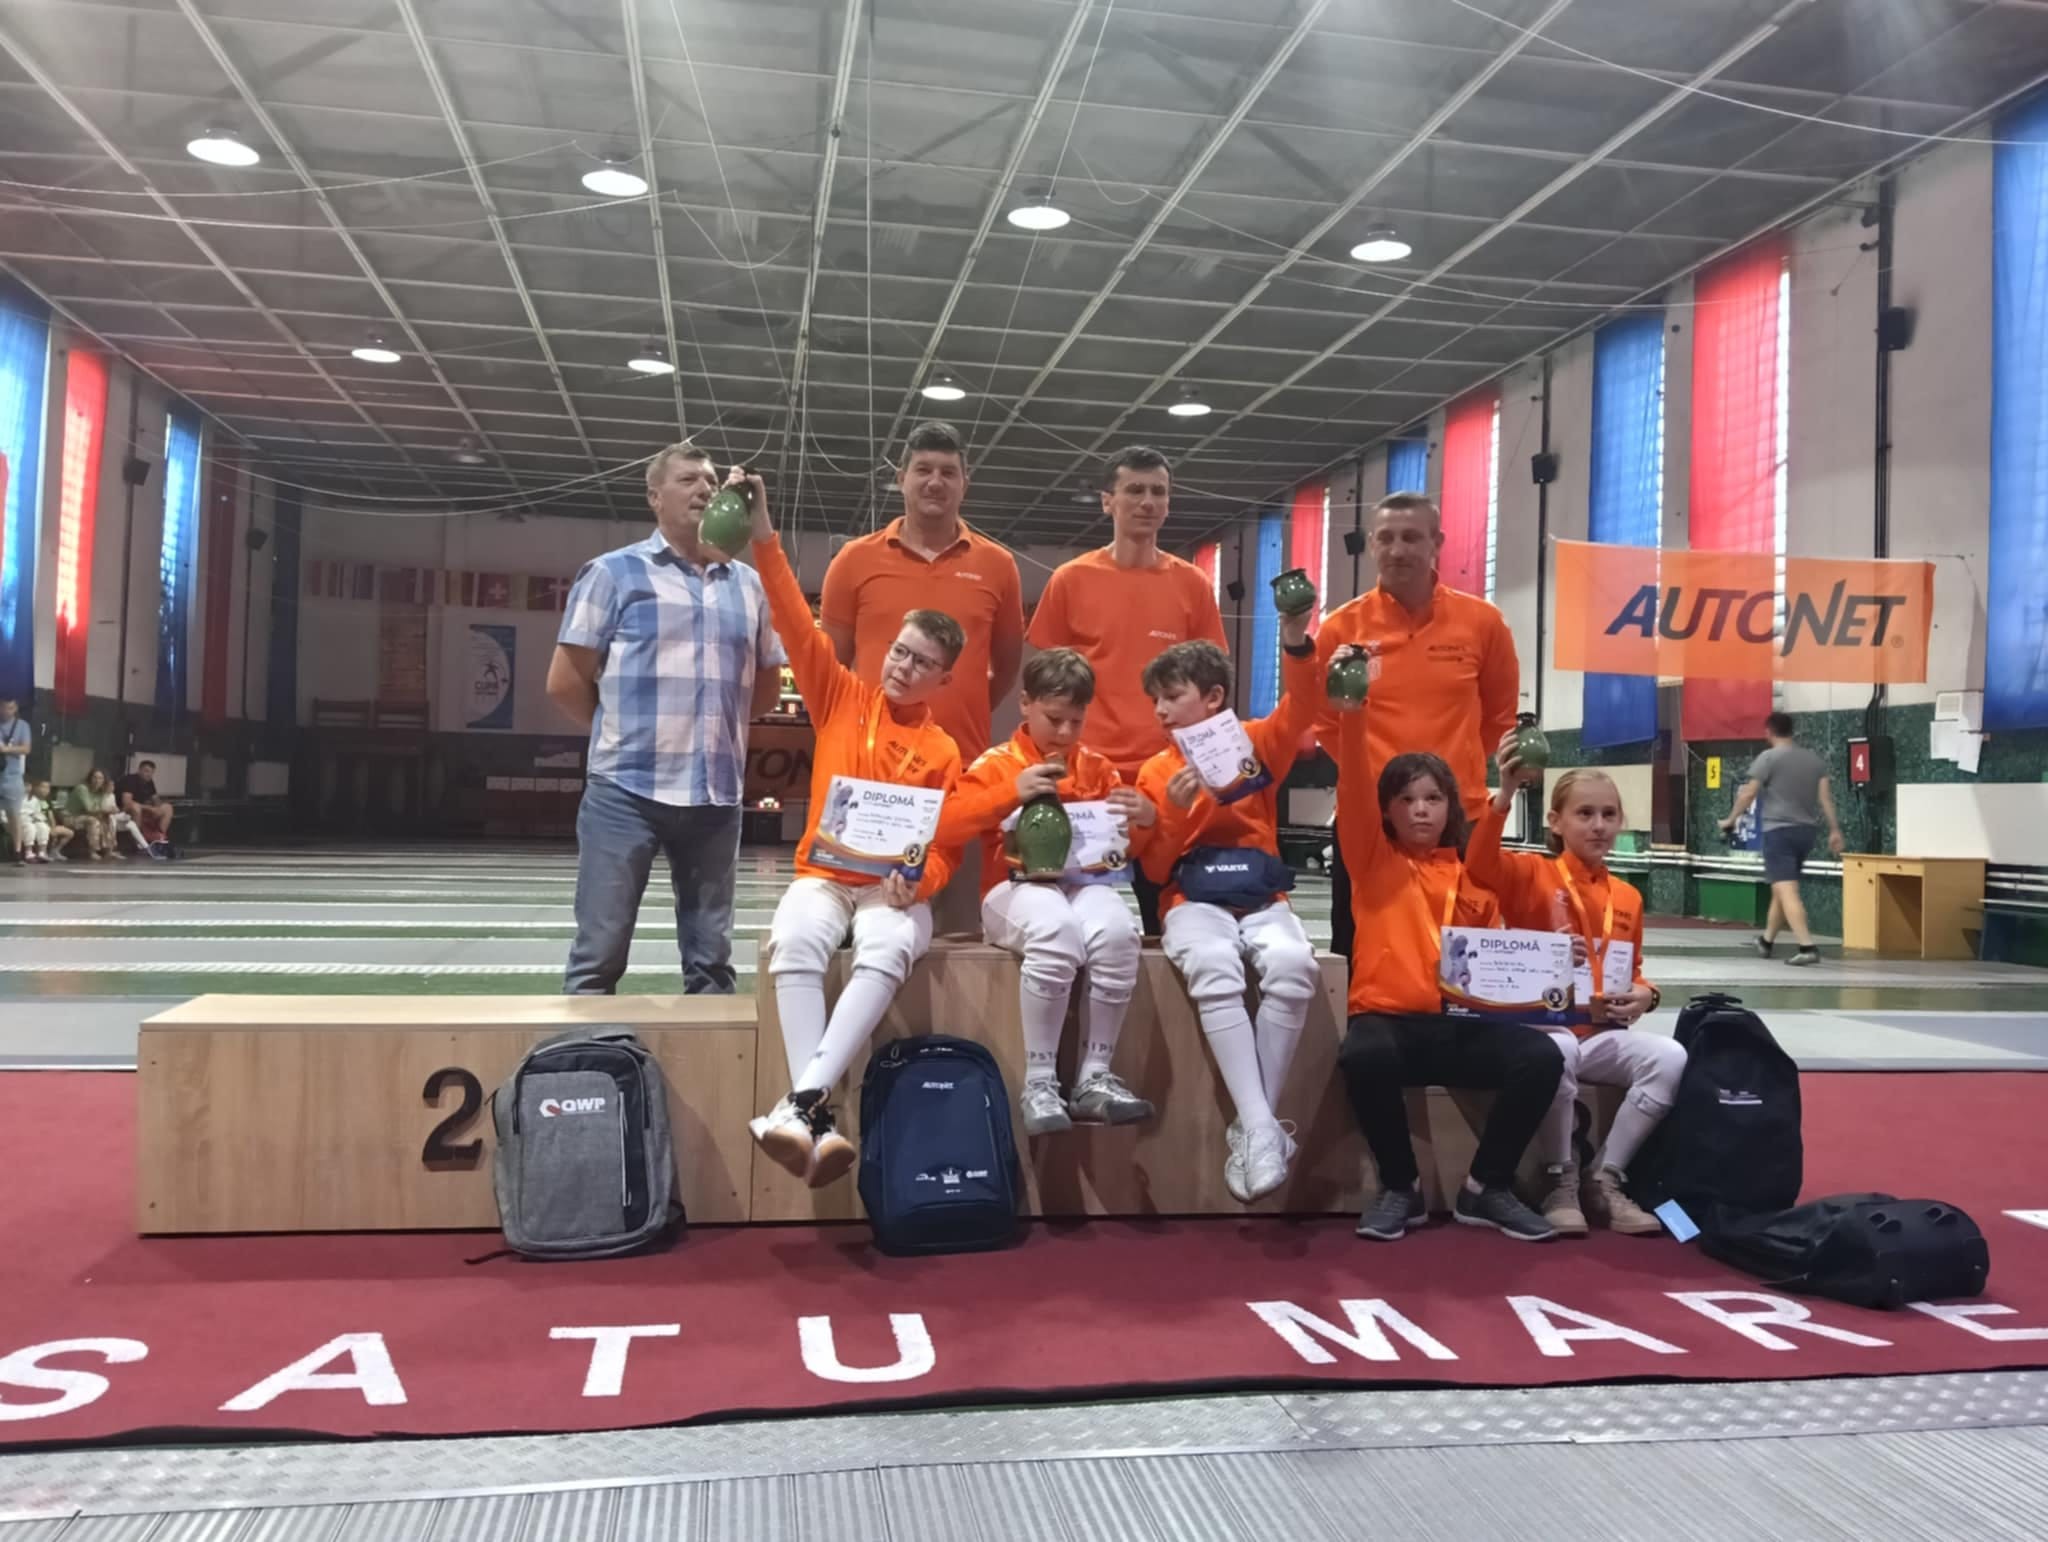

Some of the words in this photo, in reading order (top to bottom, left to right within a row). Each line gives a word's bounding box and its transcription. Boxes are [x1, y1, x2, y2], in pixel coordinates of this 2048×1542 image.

[1603, 578, 1907, 657] AUTONET
[1854, 753, 1866, 772] 4
[861, 789, 916, 808] DIPLOMĂ
[1215, 863, 1250, 873] VARTA
[1479, 937, 1541, 953] DIPLOMĂ
[560, 1096, 607, 1113] QWP
[422, 1066, 484, 1172] 2
[0, 1312, 938, 1422] SATU
[1246, 1290, 2048, 1364] MARE
